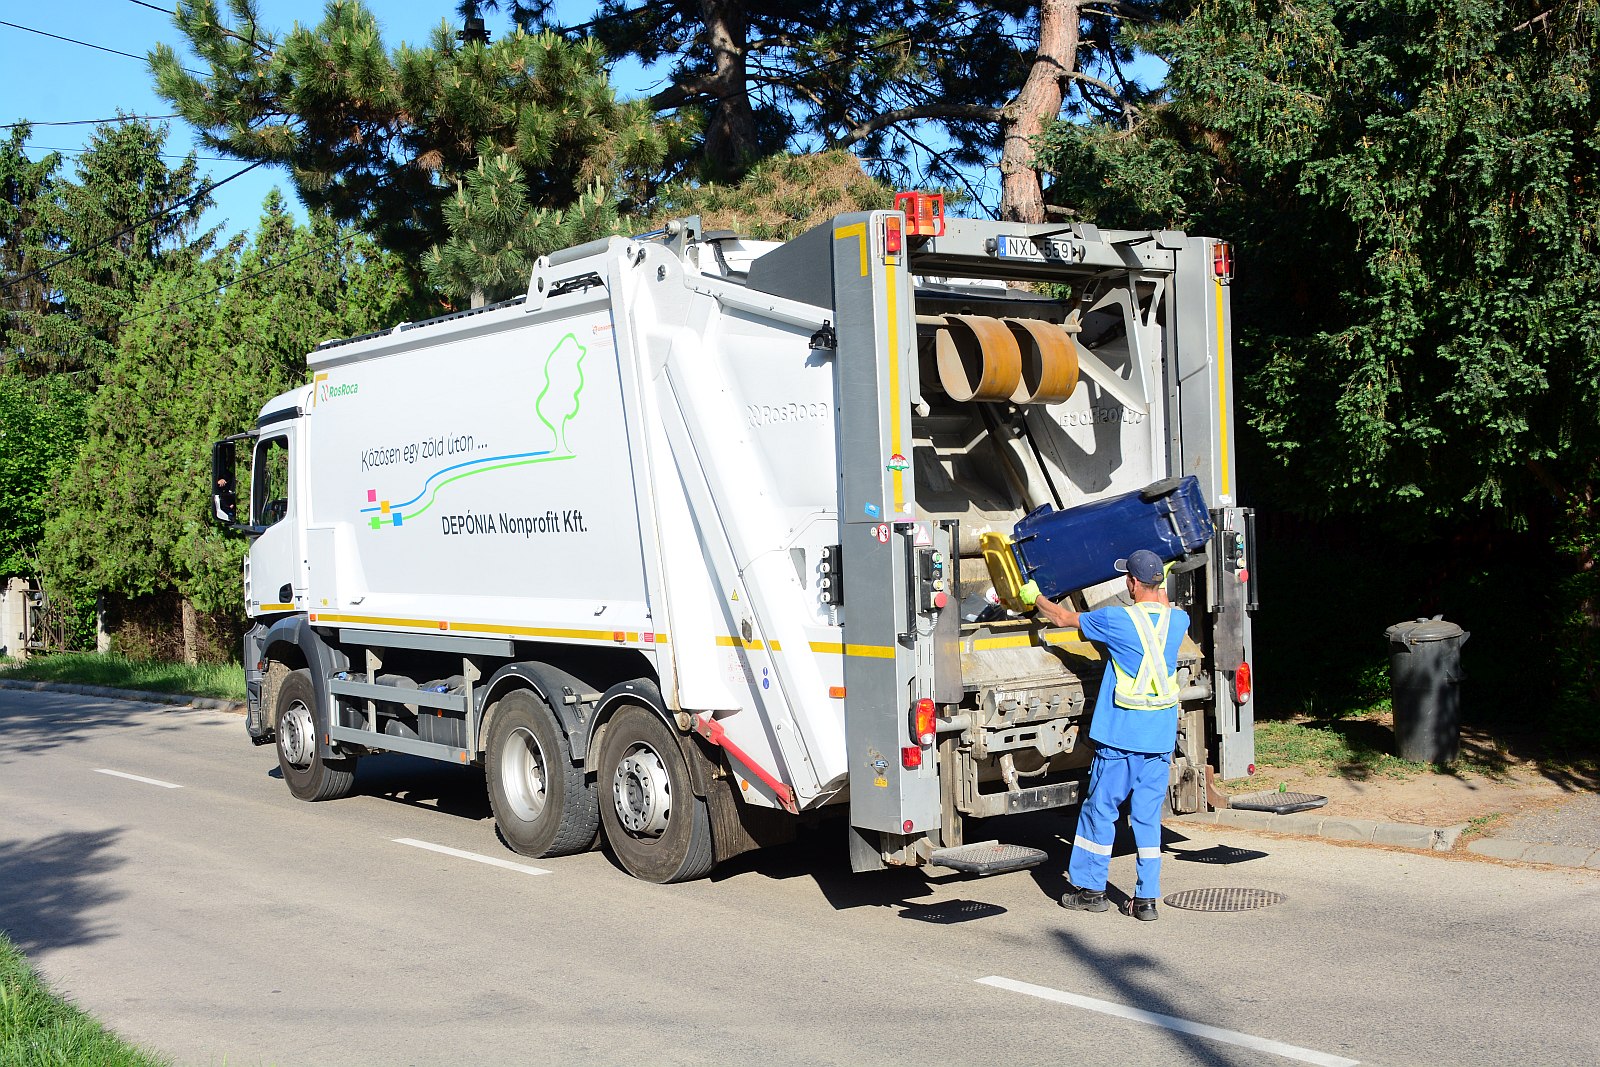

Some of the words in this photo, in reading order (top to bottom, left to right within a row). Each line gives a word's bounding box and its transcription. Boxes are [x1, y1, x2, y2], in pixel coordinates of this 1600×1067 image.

[1009, 238, 1069, 259] NXD-559
[329, 383, 359, 398] RosRoca
[761, 402, 829, 425] RosRoca
[361, 446, 401, 473] Közösen
[403, 443, 420, 464] egy
[422, 436, 444, 459] zöld
[447, 432, 474, 455] úton
[441, 509, 497, 535] DEPÓNIA
[499, 510, 561, 539] Nonprofit
[562, 509, 588, 533] Kft.
